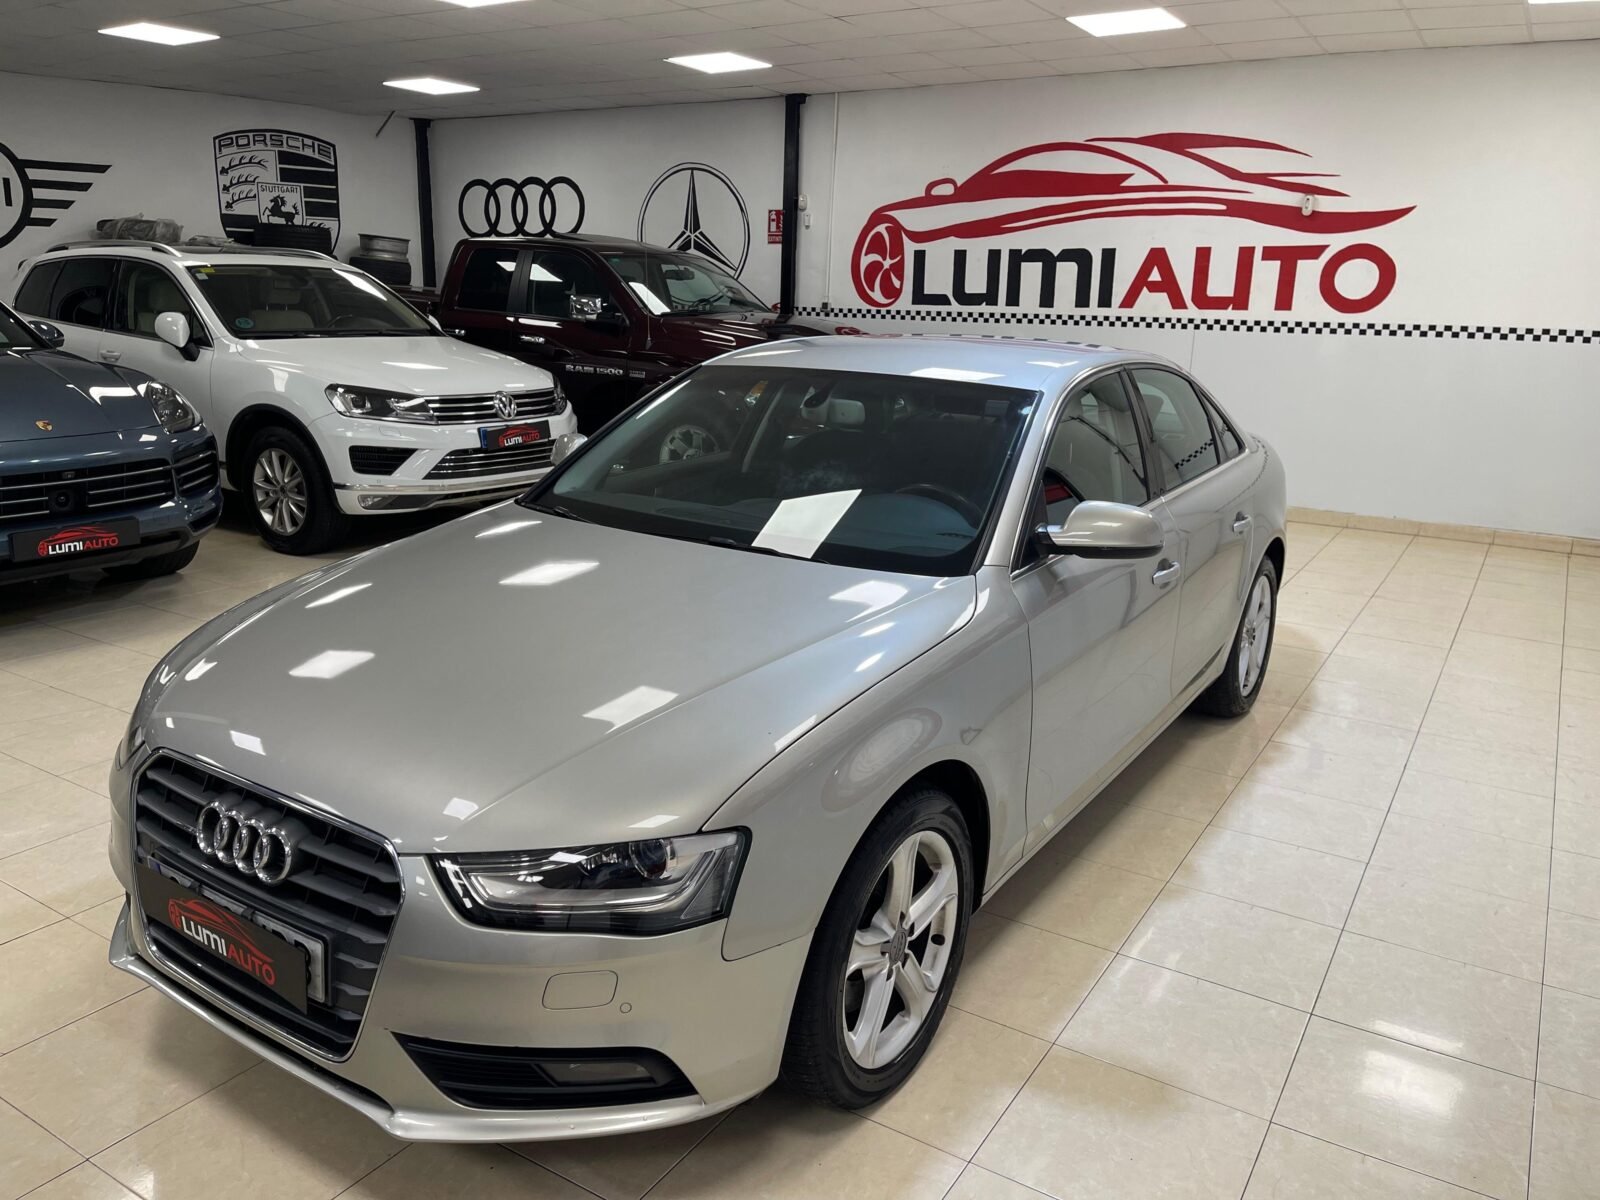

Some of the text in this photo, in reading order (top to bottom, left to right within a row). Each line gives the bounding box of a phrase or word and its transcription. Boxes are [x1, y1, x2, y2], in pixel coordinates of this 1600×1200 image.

[218, 133, 333, 160] PORSCHE
[260, 184, 299, 194] STUTTGART
[596, 367, 624, 376] 1500
